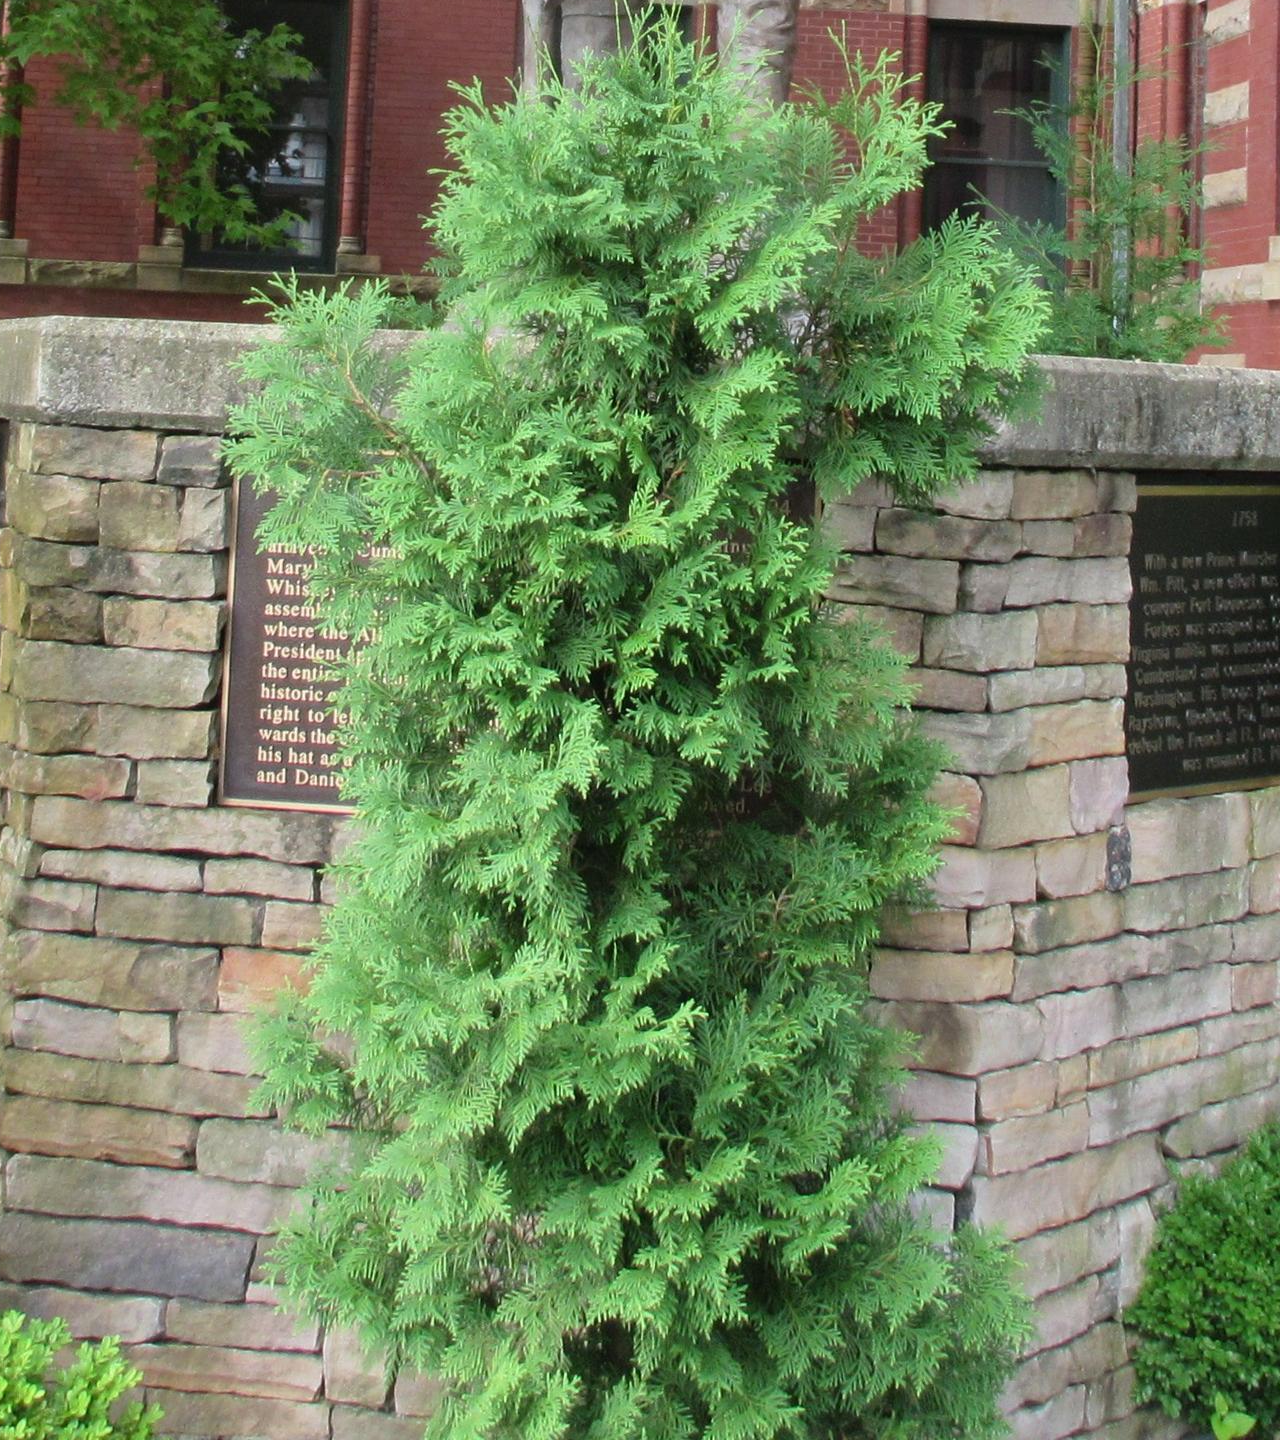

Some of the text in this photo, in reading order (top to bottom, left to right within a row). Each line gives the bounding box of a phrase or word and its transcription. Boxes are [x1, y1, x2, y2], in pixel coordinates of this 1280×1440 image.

[1144, 553, 1166, 570] With
[264, 622, 314, 639] where
[263, 641, 340, 662] President
[261, 663, 287, 679] the
[260, 683, 323, 702] historic
[259, 704, 300, 724] right
[308, 707, 325, 723] to
[259, 727, 306, 744] wards
[310, 728, 336, 745] the
[257, 746, 282, 763] his
[288, 748, 314, 766] hat
[256, 768, 286, 784] and
